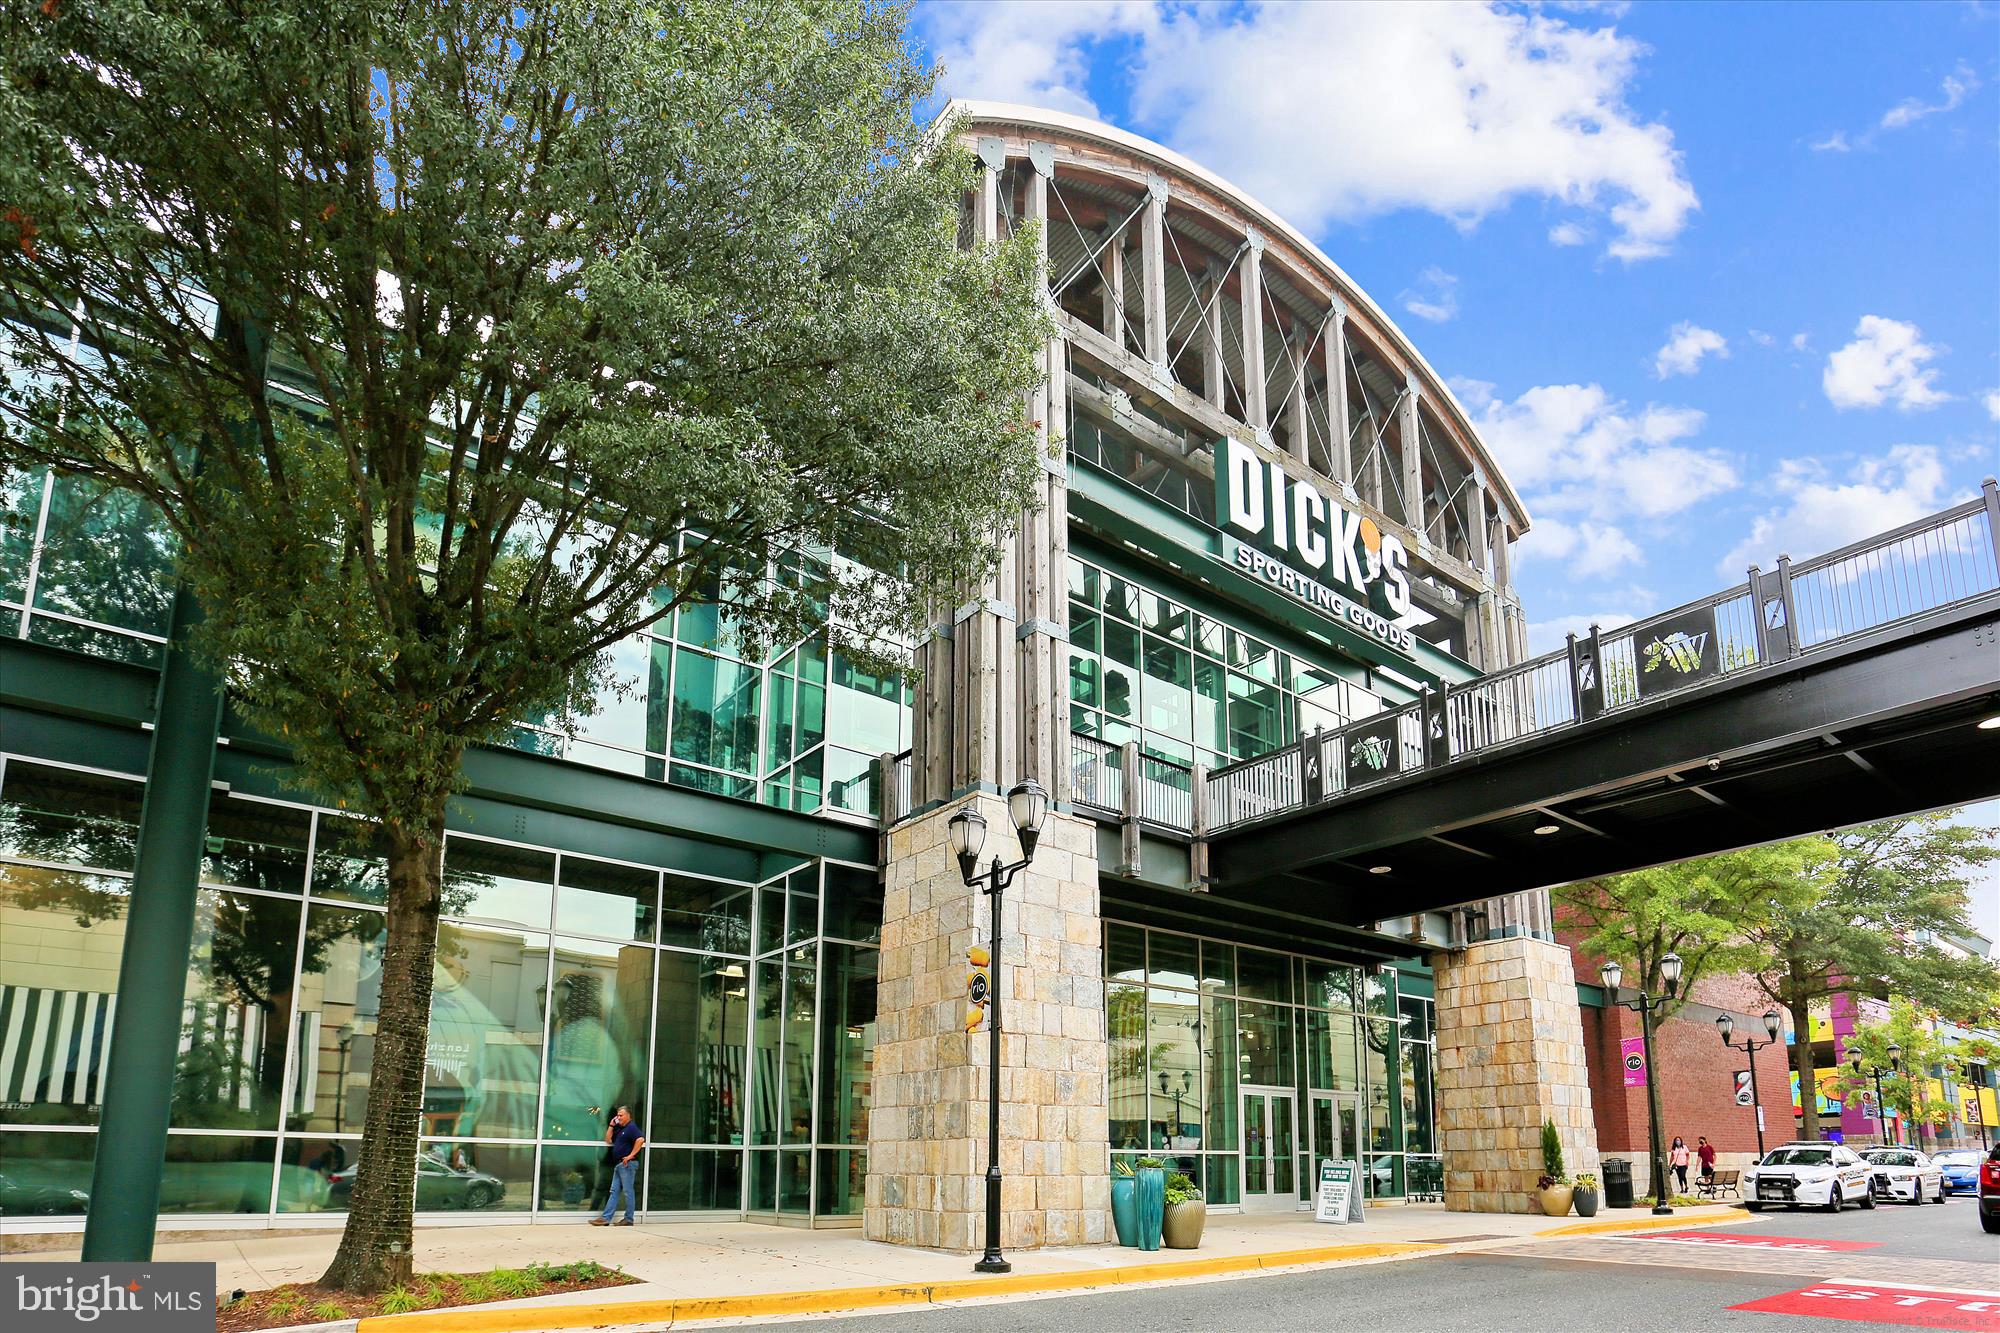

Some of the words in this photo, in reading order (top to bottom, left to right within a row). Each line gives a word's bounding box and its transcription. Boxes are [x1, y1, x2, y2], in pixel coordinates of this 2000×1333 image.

[1227, 436, 1412, 617] DICK'S
[1237, 544, 1344, 615] SPORTING
[1350, 603, 1411, 650] GOODS
[972, 981, 985, 994] rio
[1627, 1058, 1641, 1066] rio
